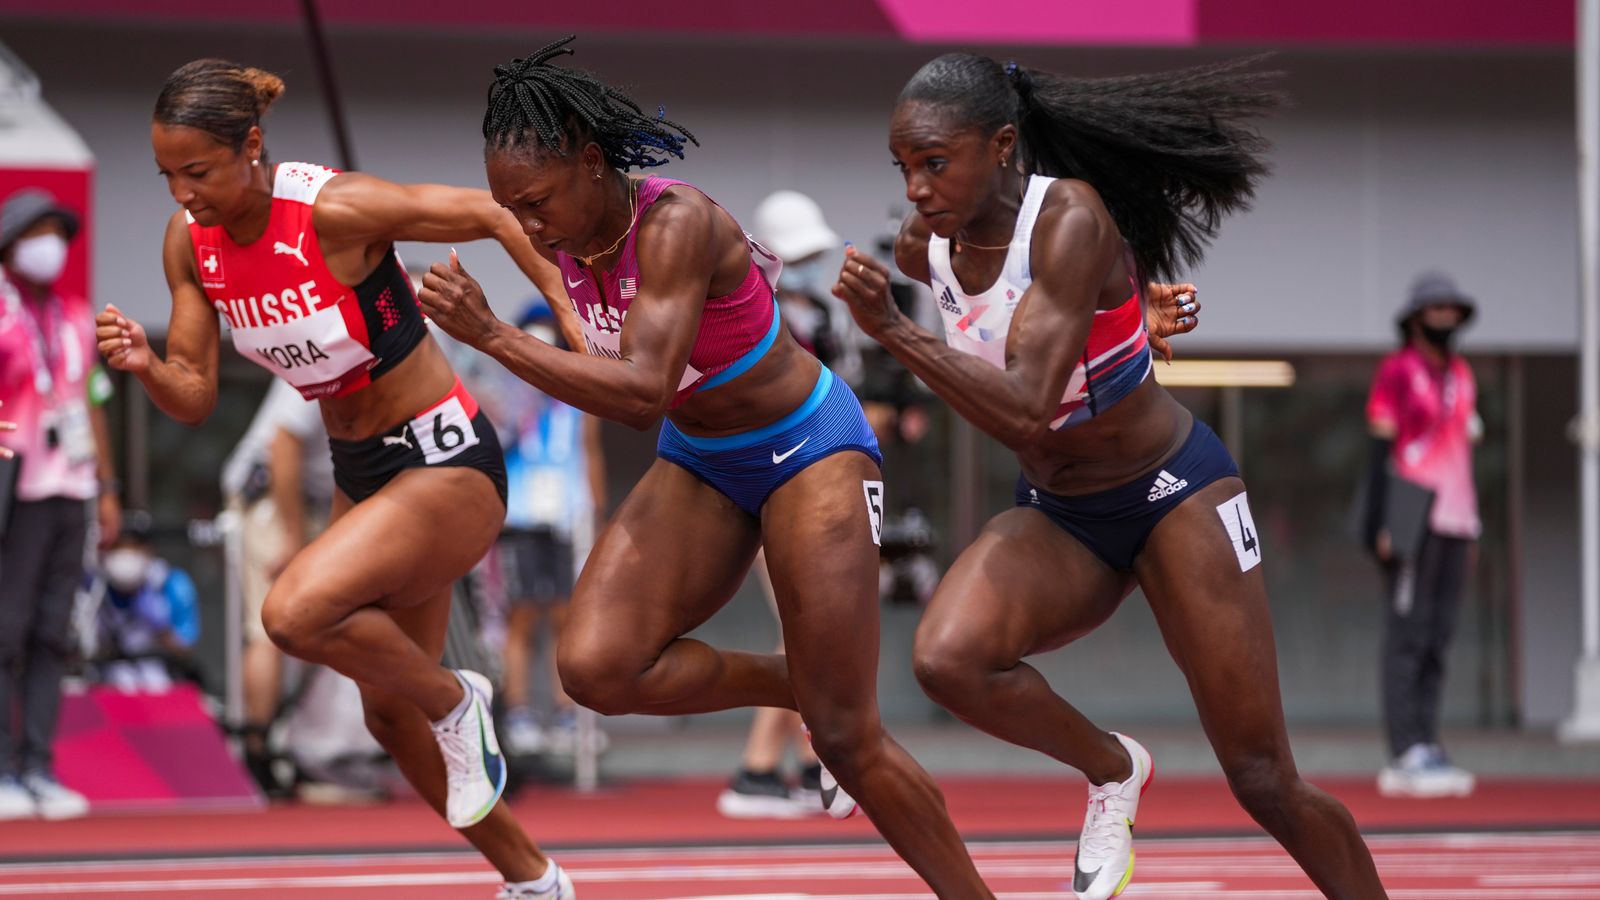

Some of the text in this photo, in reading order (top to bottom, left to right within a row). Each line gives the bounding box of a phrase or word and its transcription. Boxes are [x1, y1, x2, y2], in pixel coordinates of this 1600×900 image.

[214, 280, 321, 328] SUISSE
[433, 412, 465, 452] 6
[867, 487, 881, 537] 5
[1147, 479, 1188, 502] adidas
[1235, 503, 1258, 557] 4
